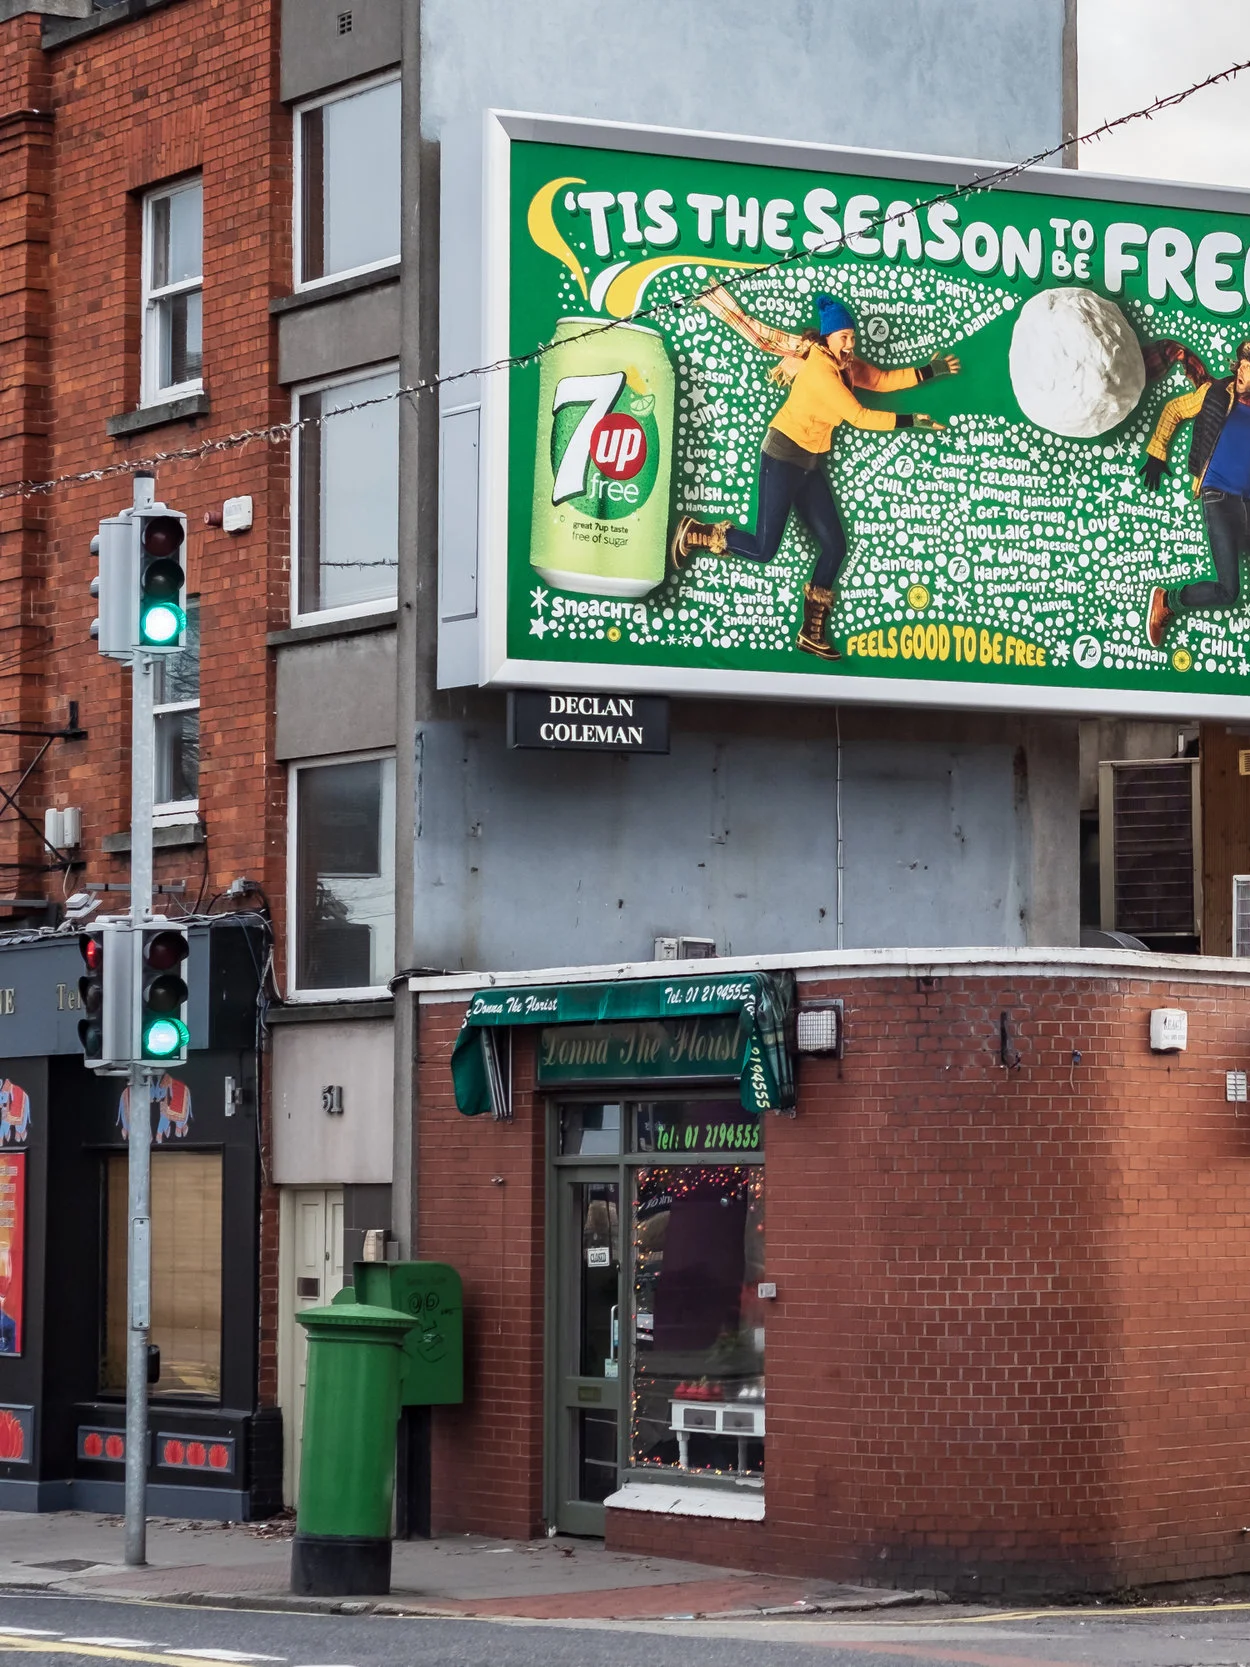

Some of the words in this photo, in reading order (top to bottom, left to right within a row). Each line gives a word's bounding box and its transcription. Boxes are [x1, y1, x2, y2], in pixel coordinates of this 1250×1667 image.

[564, 189, 679, 256] 'TIS
[687, 193, 794, 252] THE
[803, 188, 1042, 280] SEASON
[1050, 218, 1094, 250] TO
[1051, 250, 1090, 279] BE
[589, 472, 639, 504] free
[592, 533, 602, 543] of
[604, 536, 629, 547] sugar
[847, 626, 898, 659] FEELS
[900, 624, 950, 661] GOOD
[952, 625, 977, 663] TO
[979, 629, 1003, 665] BE
[1005, 635, 1047, 668] FREE
[549, 696, 634, 717] DECLAN
[539, 723, 644, 744] COLEMAN
[473, 998, 504, 1015] Donna
[506, 996, 523, 1014] The
[525, 995, 558, 1014] Florist
[685, 986, 699, 1003] 01
[542, 1033, 610, 1066] Donna
[620, 1028, 661, 1065] The
[669, 1021, 741, 1063] Florist
[657, 1125, 679, 1150] Tel:
[684, 1124, 699, 1148] 01
[704, 1122, 761, 1149] 2194555
